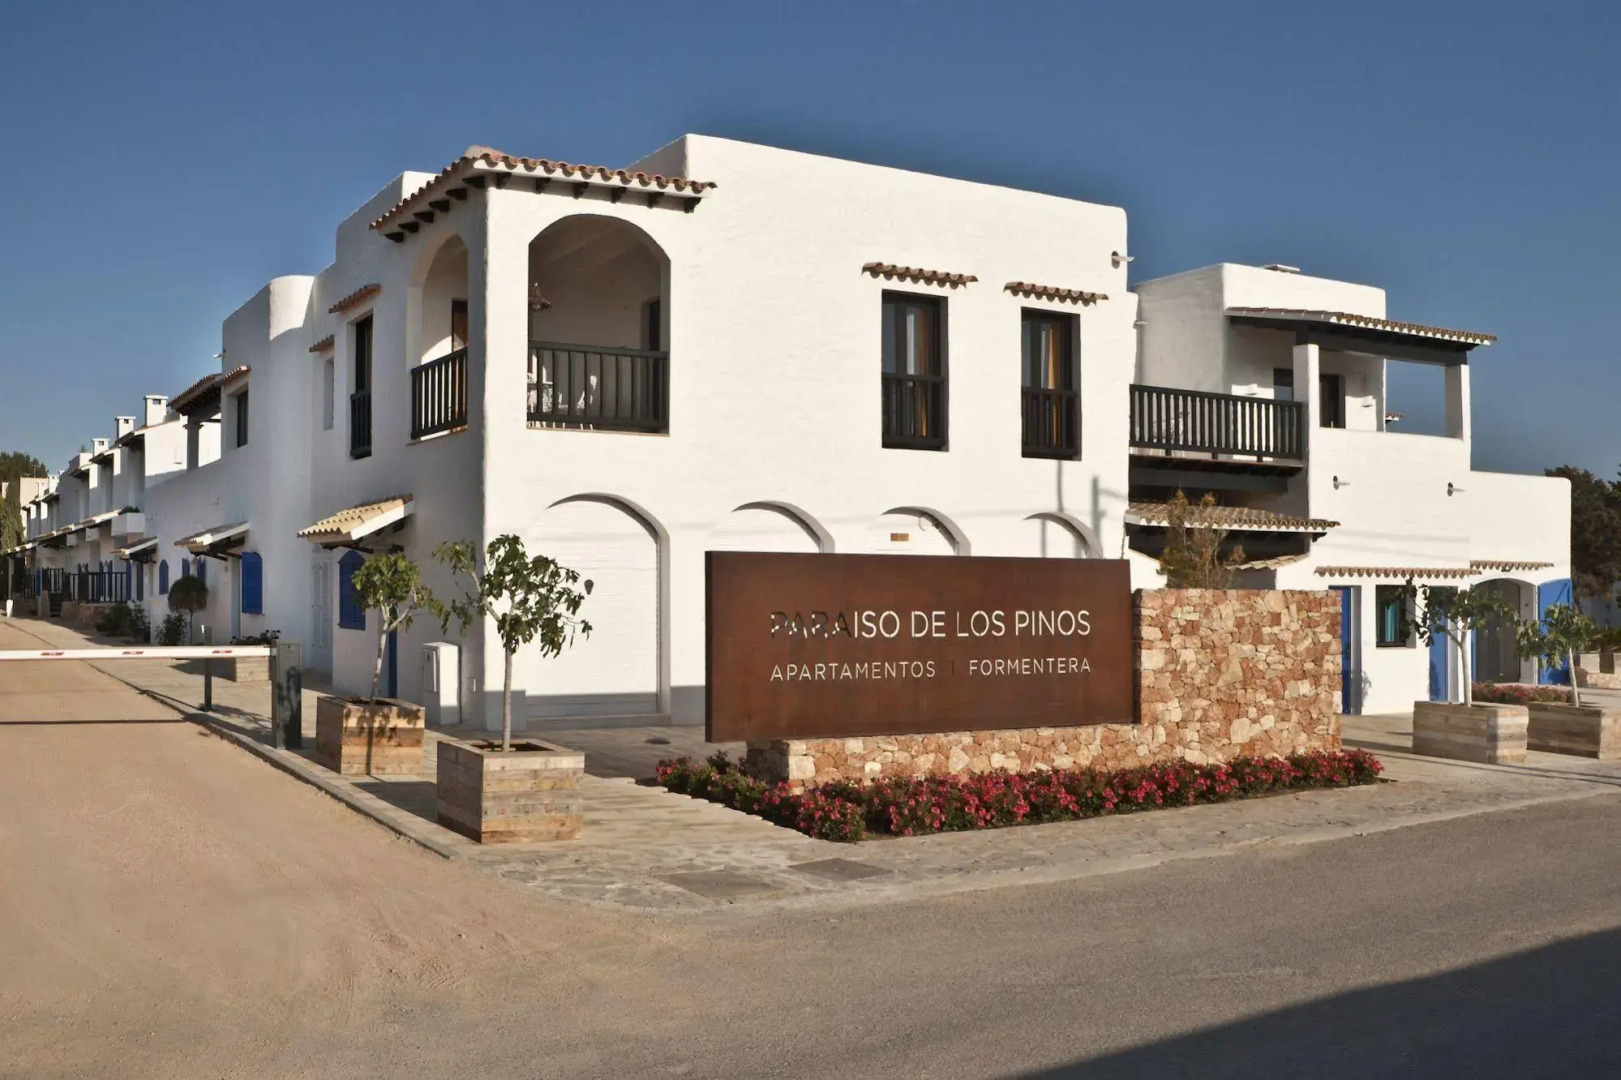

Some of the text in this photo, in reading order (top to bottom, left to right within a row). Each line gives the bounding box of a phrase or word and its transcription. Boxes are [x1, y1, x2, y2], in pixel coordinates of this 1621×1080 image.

[771, 609, 1091, 639] PARAISO DE LOS PINOS
[770, 657, 1091, 682] APARTAMENTOS FORMENTERA
